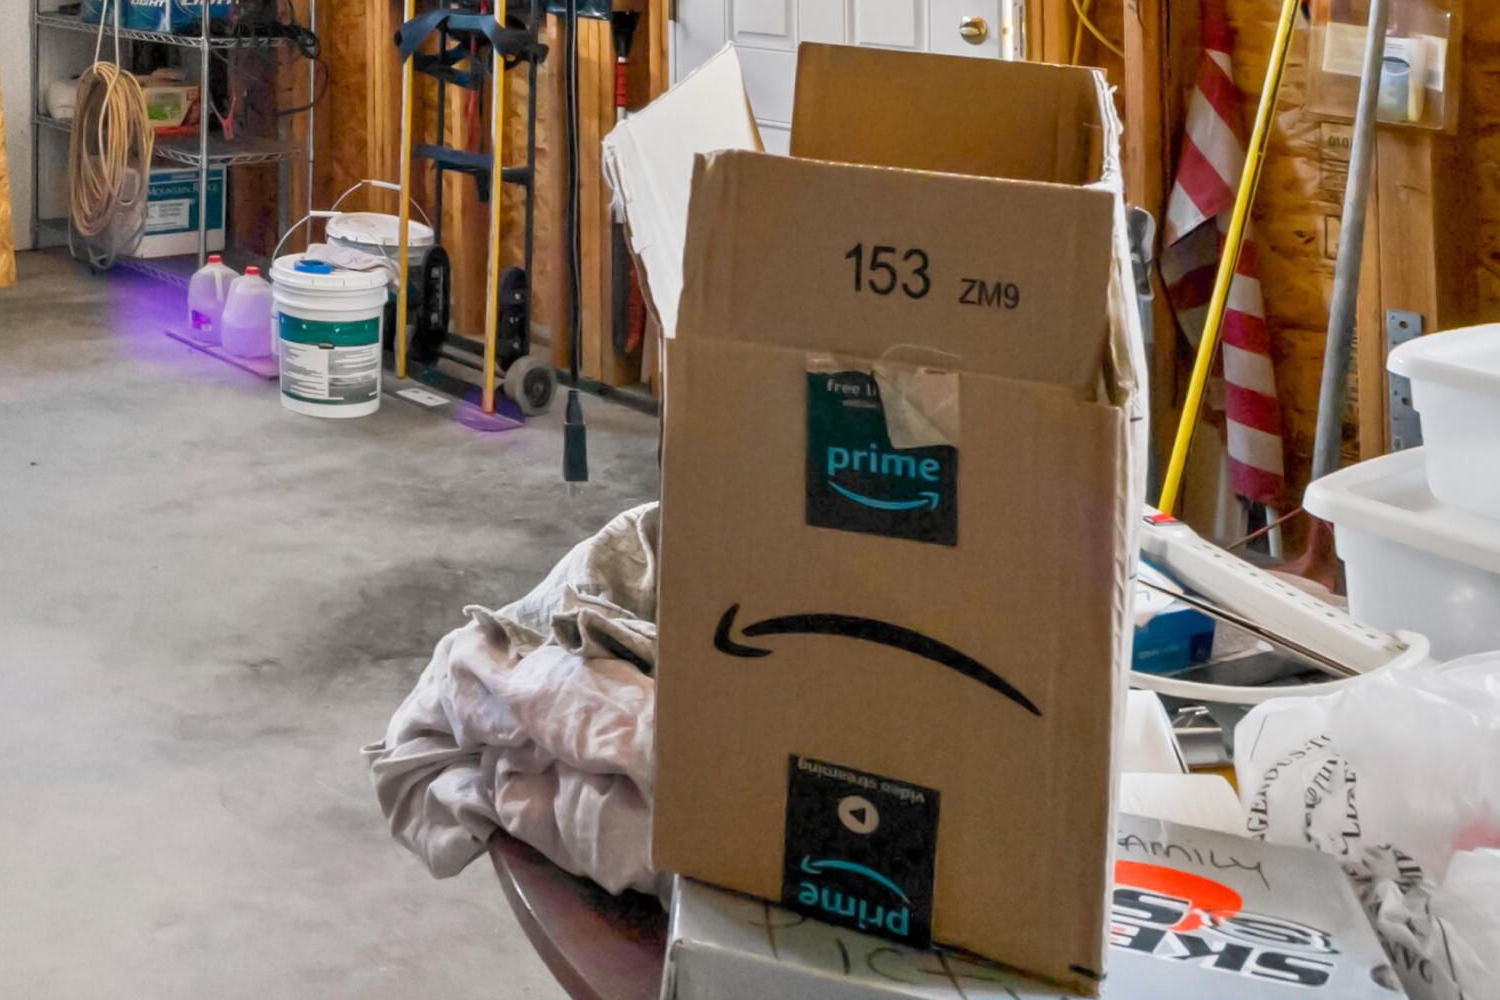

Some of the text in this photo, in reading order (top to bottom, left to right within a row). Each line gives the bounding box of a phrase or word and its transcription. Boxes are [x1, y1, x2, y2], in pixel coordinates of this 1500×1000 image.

[845, 242, 1021, 310] 153 ZM9
[826, 378, 861, 396] free
[827, 443, 941, 482] prime
[797, 757, 926, 805] video streaming
[798, 880, 911, 937] prime
